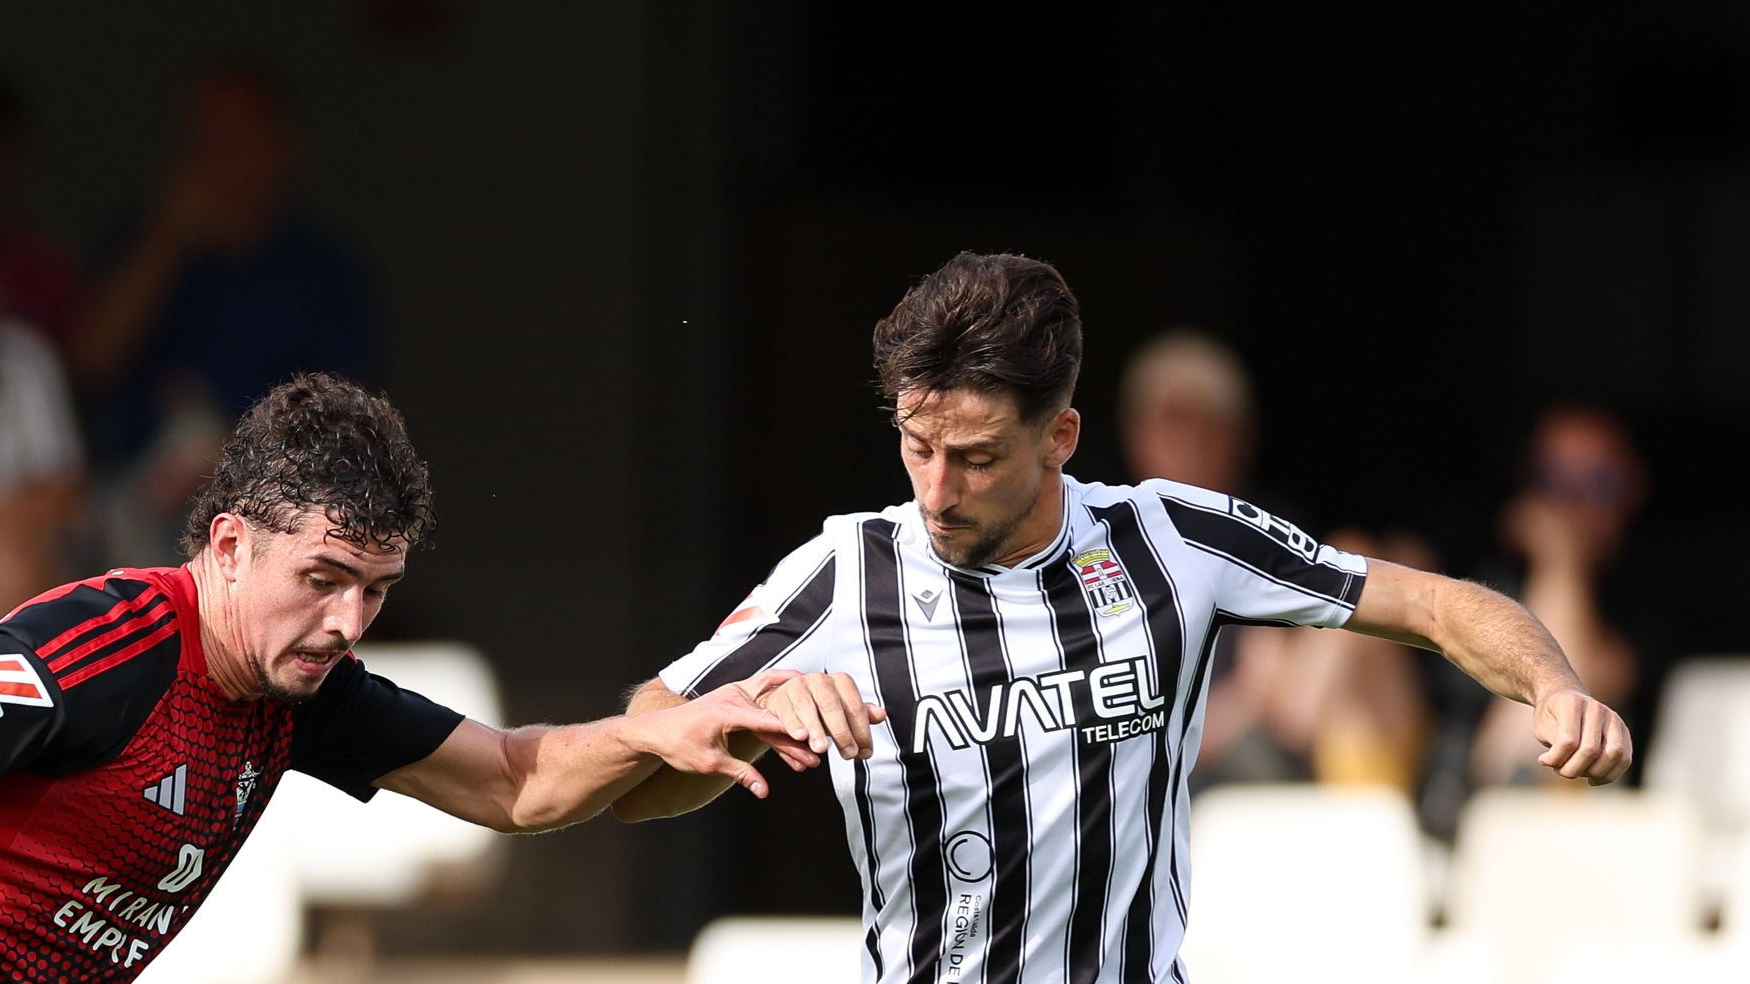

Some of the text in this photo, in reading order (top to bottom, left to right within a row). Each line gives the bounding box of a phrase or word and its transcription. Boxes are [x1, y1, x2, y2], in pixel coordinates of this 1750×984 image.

[913, 659, 1165, 754] AVATEL
[1081, 710, 1165, 744] TELECOM
[82, 876, 188, 935] MIRAN
[948, 953, 964, 977] DE
